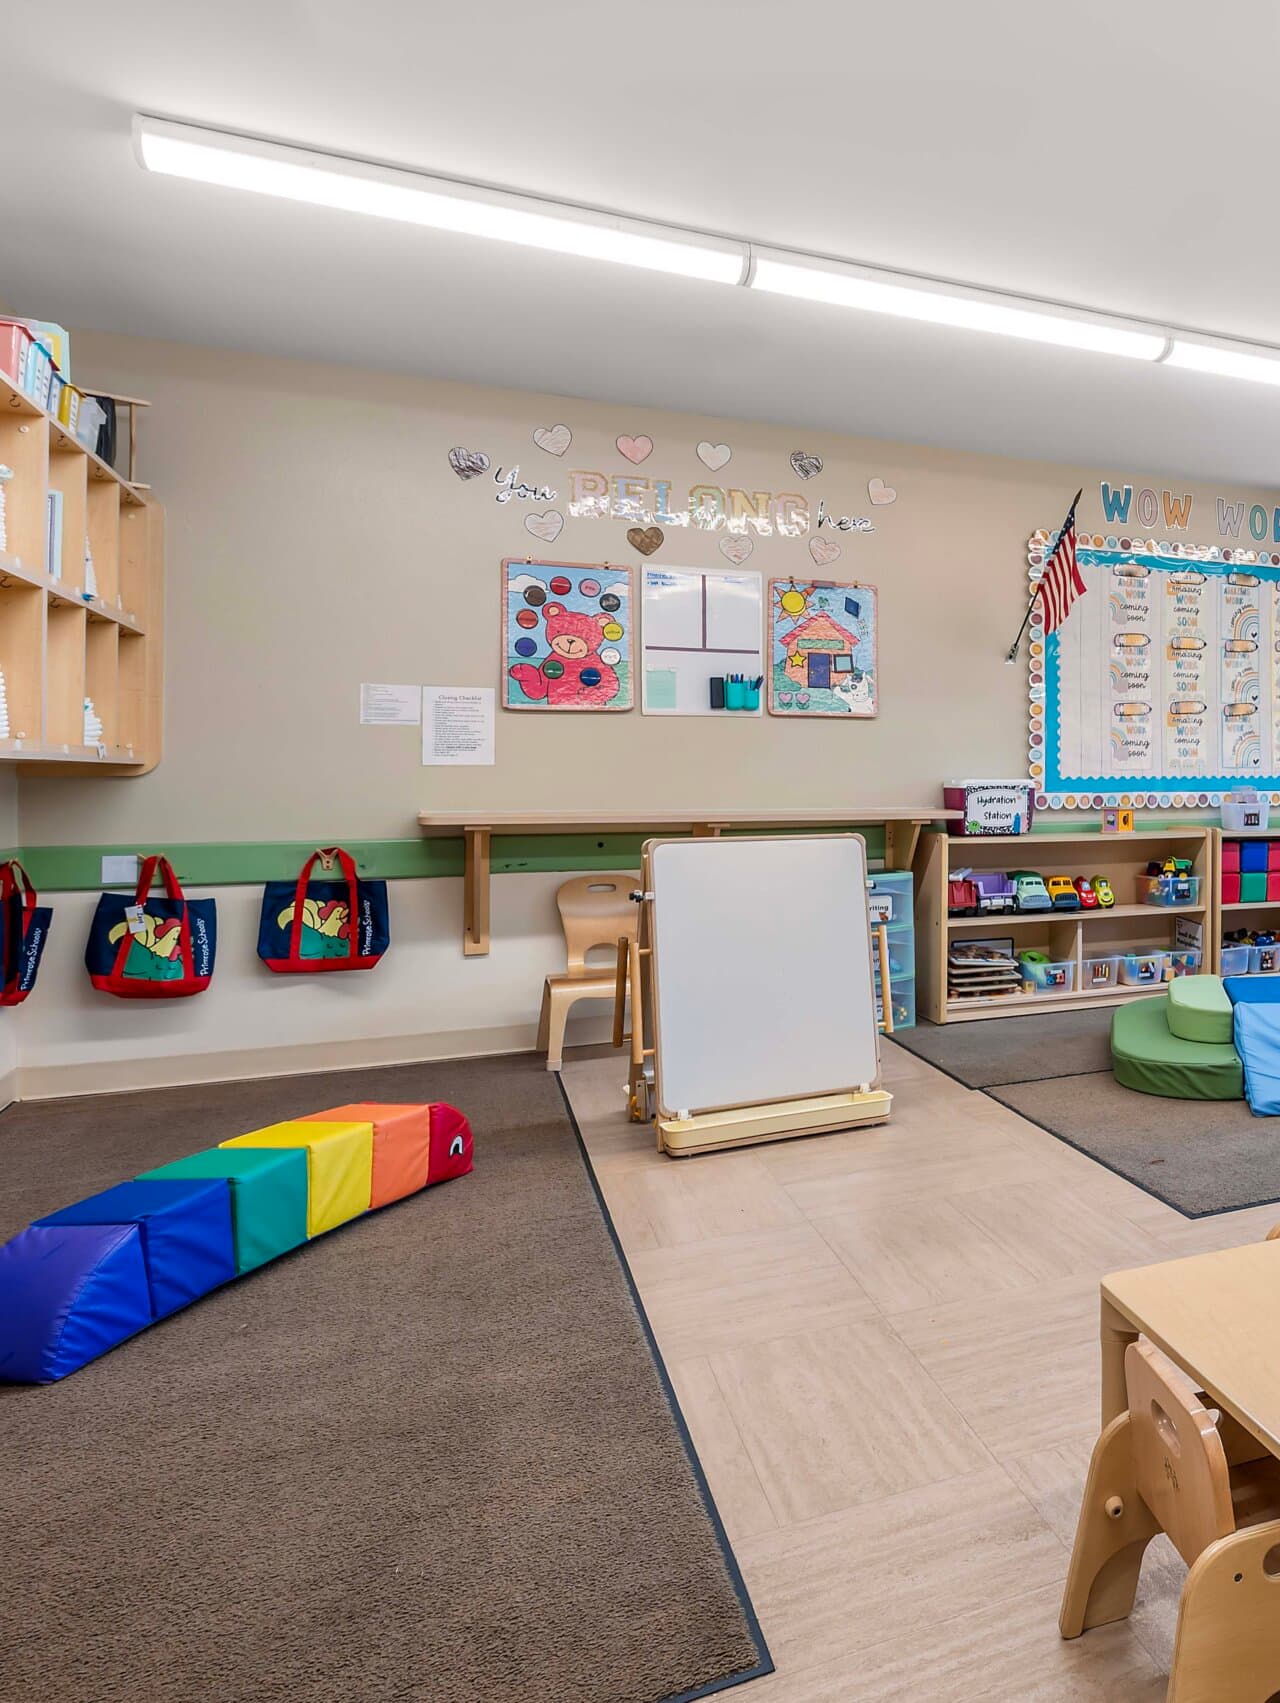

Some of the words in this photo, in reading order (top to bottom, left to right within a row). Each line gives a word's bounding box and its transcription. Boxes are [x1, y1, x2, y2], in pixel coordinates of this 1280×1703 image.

[494, 465, 557, 503] You
[568, 470, 810, 537] BELONG
[817, 499, 876, 533] here
[1100, 482, 1193, 531] WOW
[1171, 586, 1202, 596] Amazing
[1120, 604, 1149, 615] coming
[1173, 607, 1200, 616] coming
[1127, 614, 1146, 622] soon
[1171, 651, 1202, 660] Amazing
[1120, 671, 1149, 682] coming
[1173, 671, 1200, 680] coming
[1172, 716, 1203, 726] Amazing
[1121, 738, 1150, 749] coming
[1174, 737, 1200, 746] coming
[1127, 750, 1147, 758] soon
[977, 794, 1017, 806] Hydration
[984, 811, 1012, 821] Station
[363, 900, 373, 925] Schools
[196, 918, 208, 944] Schools
[27, 928, 42, 956] Schools
[362, 925, 373, 956] Primrose
[200, 943, 210, 976] Primrose
[20, 956, 36, 991] Primrose
